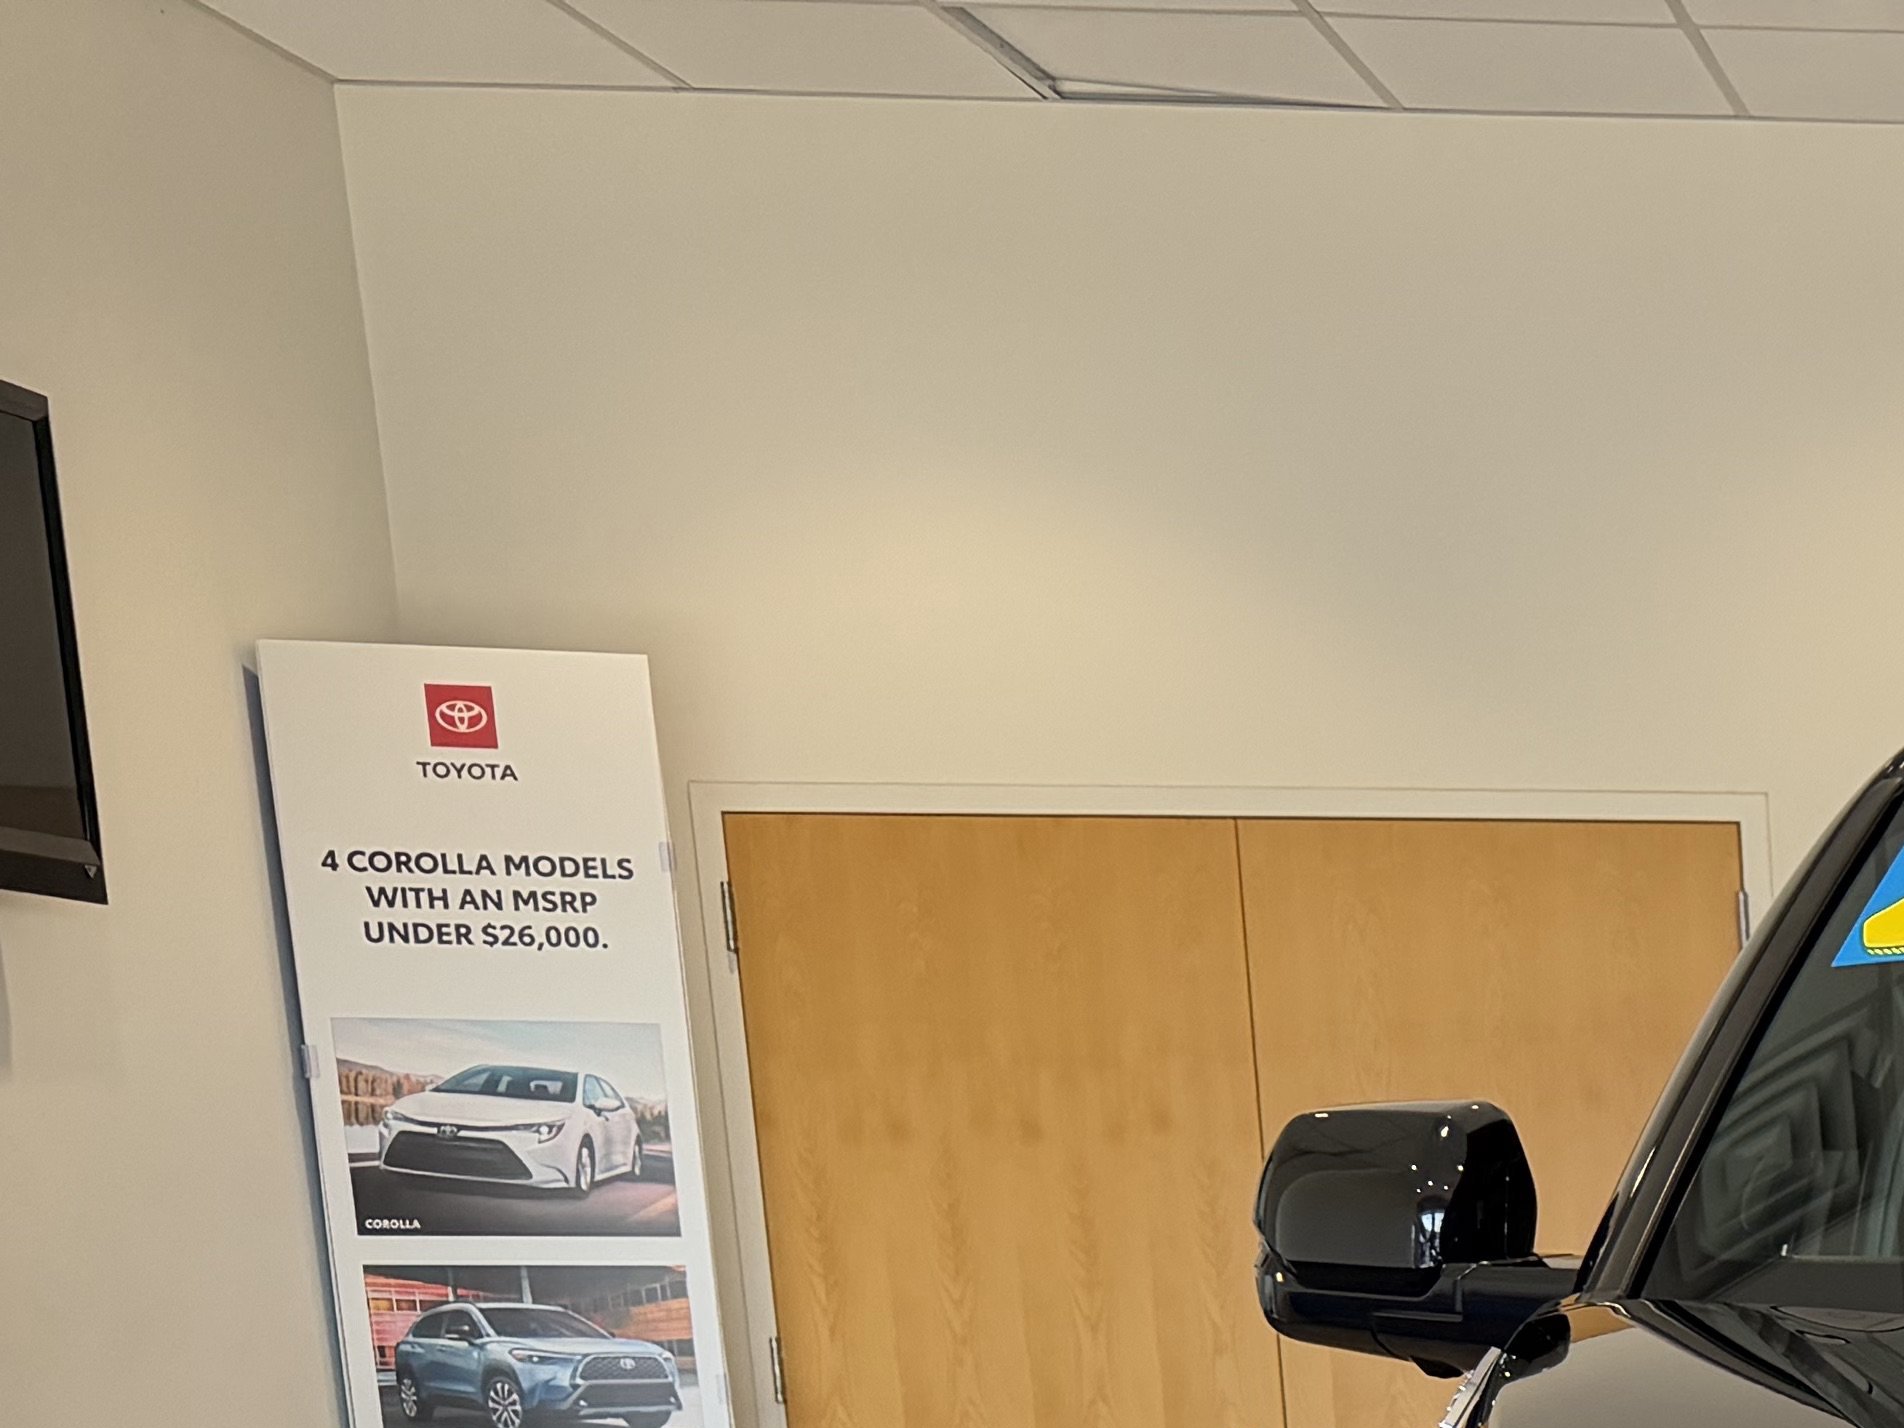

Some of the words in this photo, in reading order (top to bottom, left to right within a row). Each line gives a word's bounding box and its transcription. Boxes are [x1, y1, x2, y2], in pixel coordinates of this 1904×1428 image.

[415, 761, 519, 782] TOYOTA
[321, 849, 339, 872] 4
[346, 850, 497, 877] COROLLA
[504, 854, 635, 881] MODELS
[365, 886, 450, 911] WITH
[459, 888, 503, 912] AN
[512, 890, 598, 914] MSRP
[363, 921, 474, 946] UNDER
[481, 922, 609, 951] $26,000.
[364, 1218, 422, 1230] COROLLA
